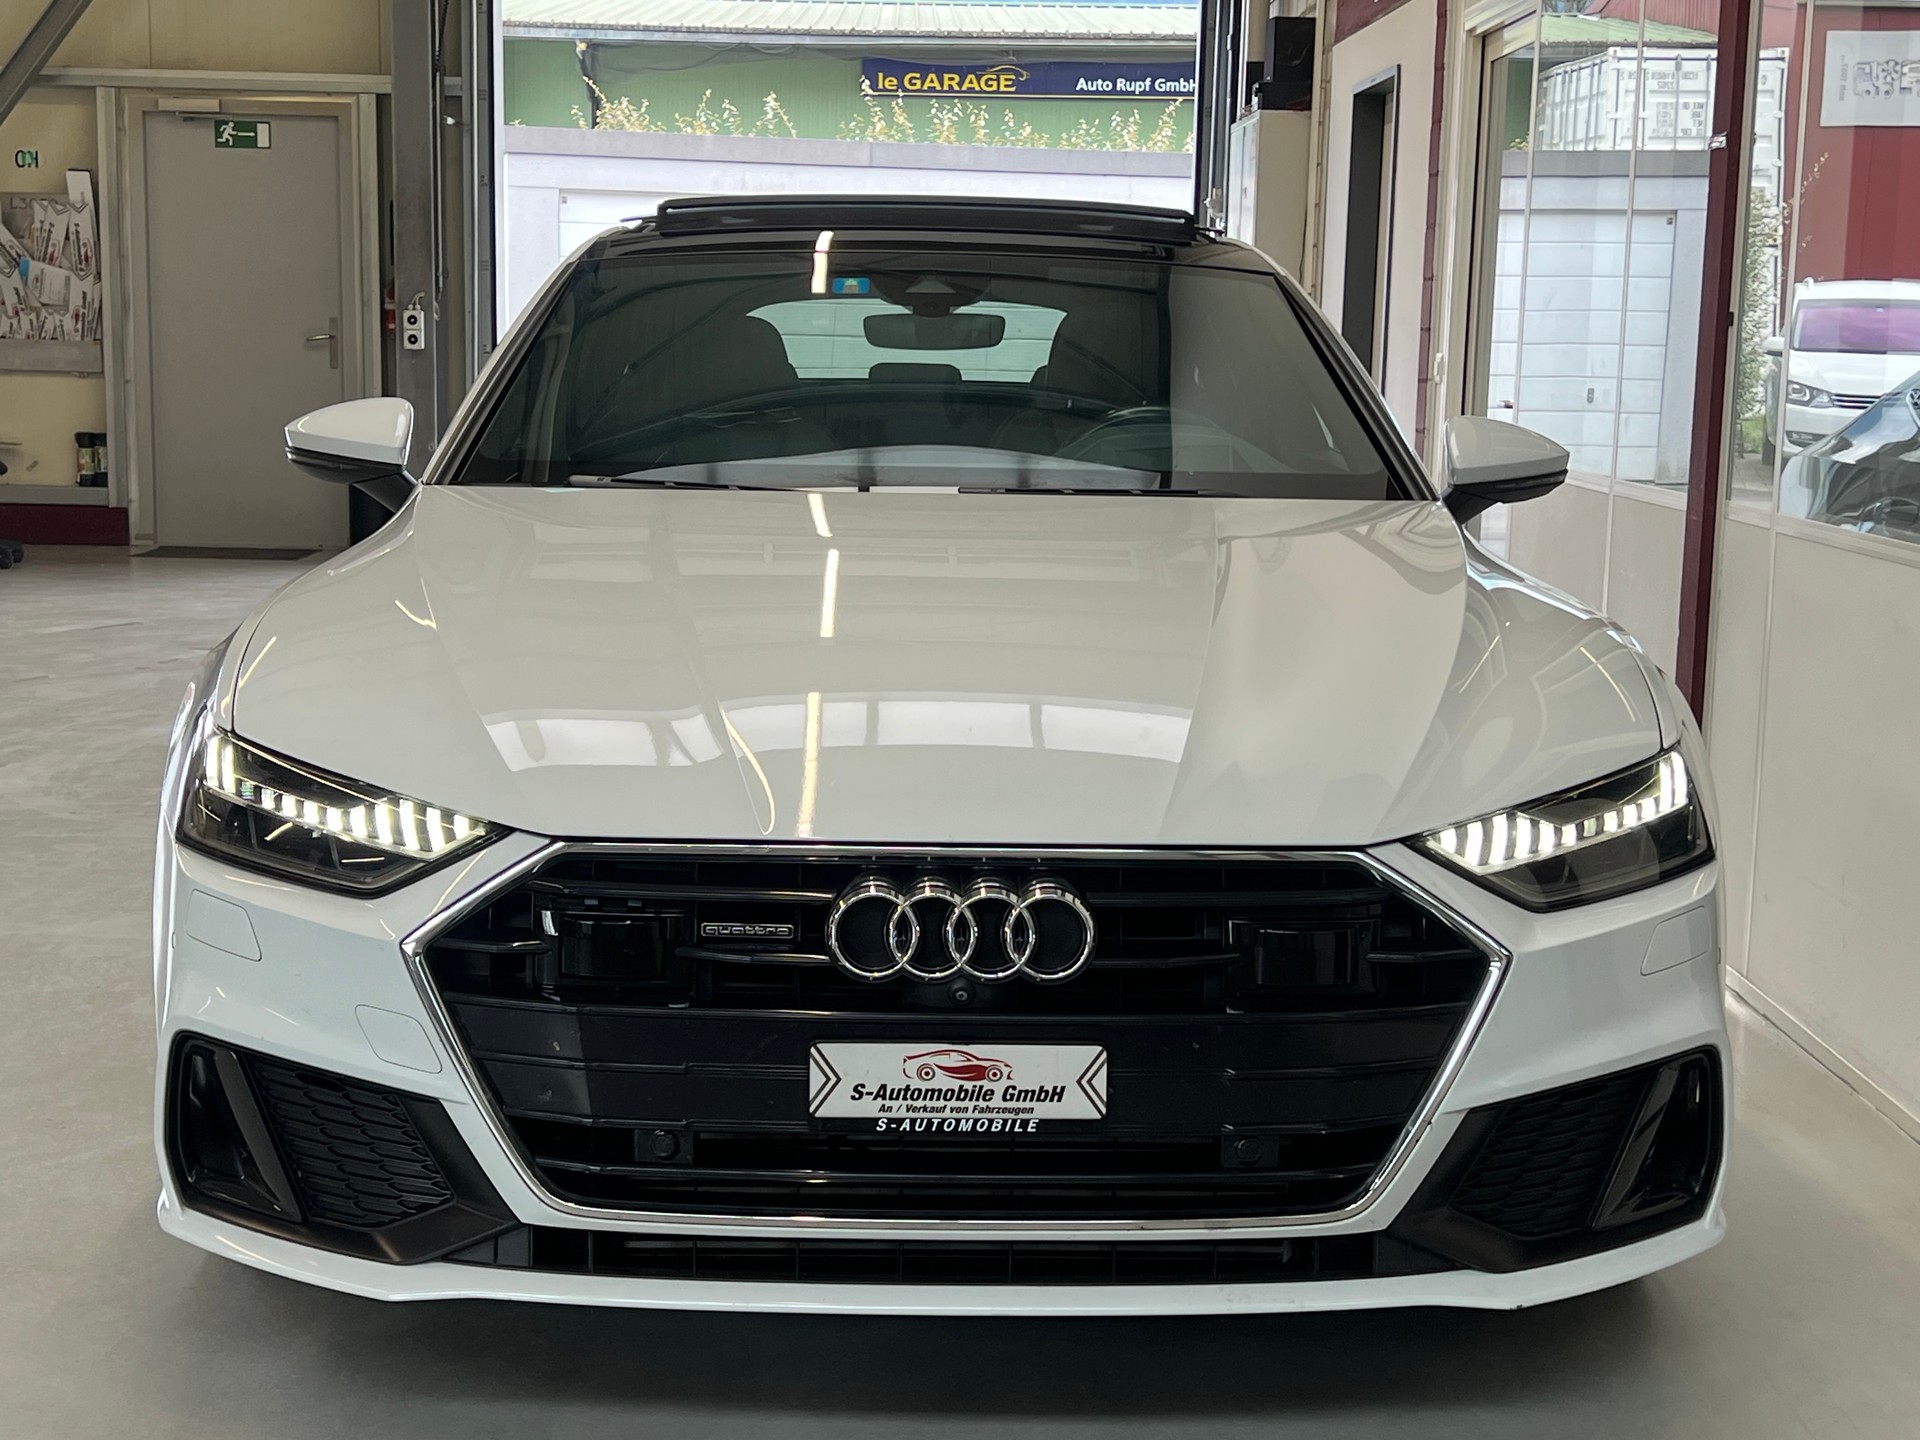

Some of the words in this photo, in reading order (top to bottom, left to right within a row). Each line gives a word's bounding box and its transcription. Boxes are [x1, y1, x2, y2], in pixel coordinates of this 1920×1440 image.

[877, 72, 898, 90] le
[903, 73, 1017, 92] GARAGE
[1075, 77, 1113, 92] Auto
[1116, 77, 1152, 95] Rupf
[1154, 77, 1197, 92] GmbH
[705, 926, 790, 936] quattro
[850, 1083, 996, 1102] S-Automobile
[1001, 1085, 1066, 1103] GmbH
[878, 1104, 893, 1114] An
[905, 1104, 947, 1114] Verkauf
[949, 1106, 969, 1114] von
[971, 1104, 1035, 1116] Fahrzeugen
